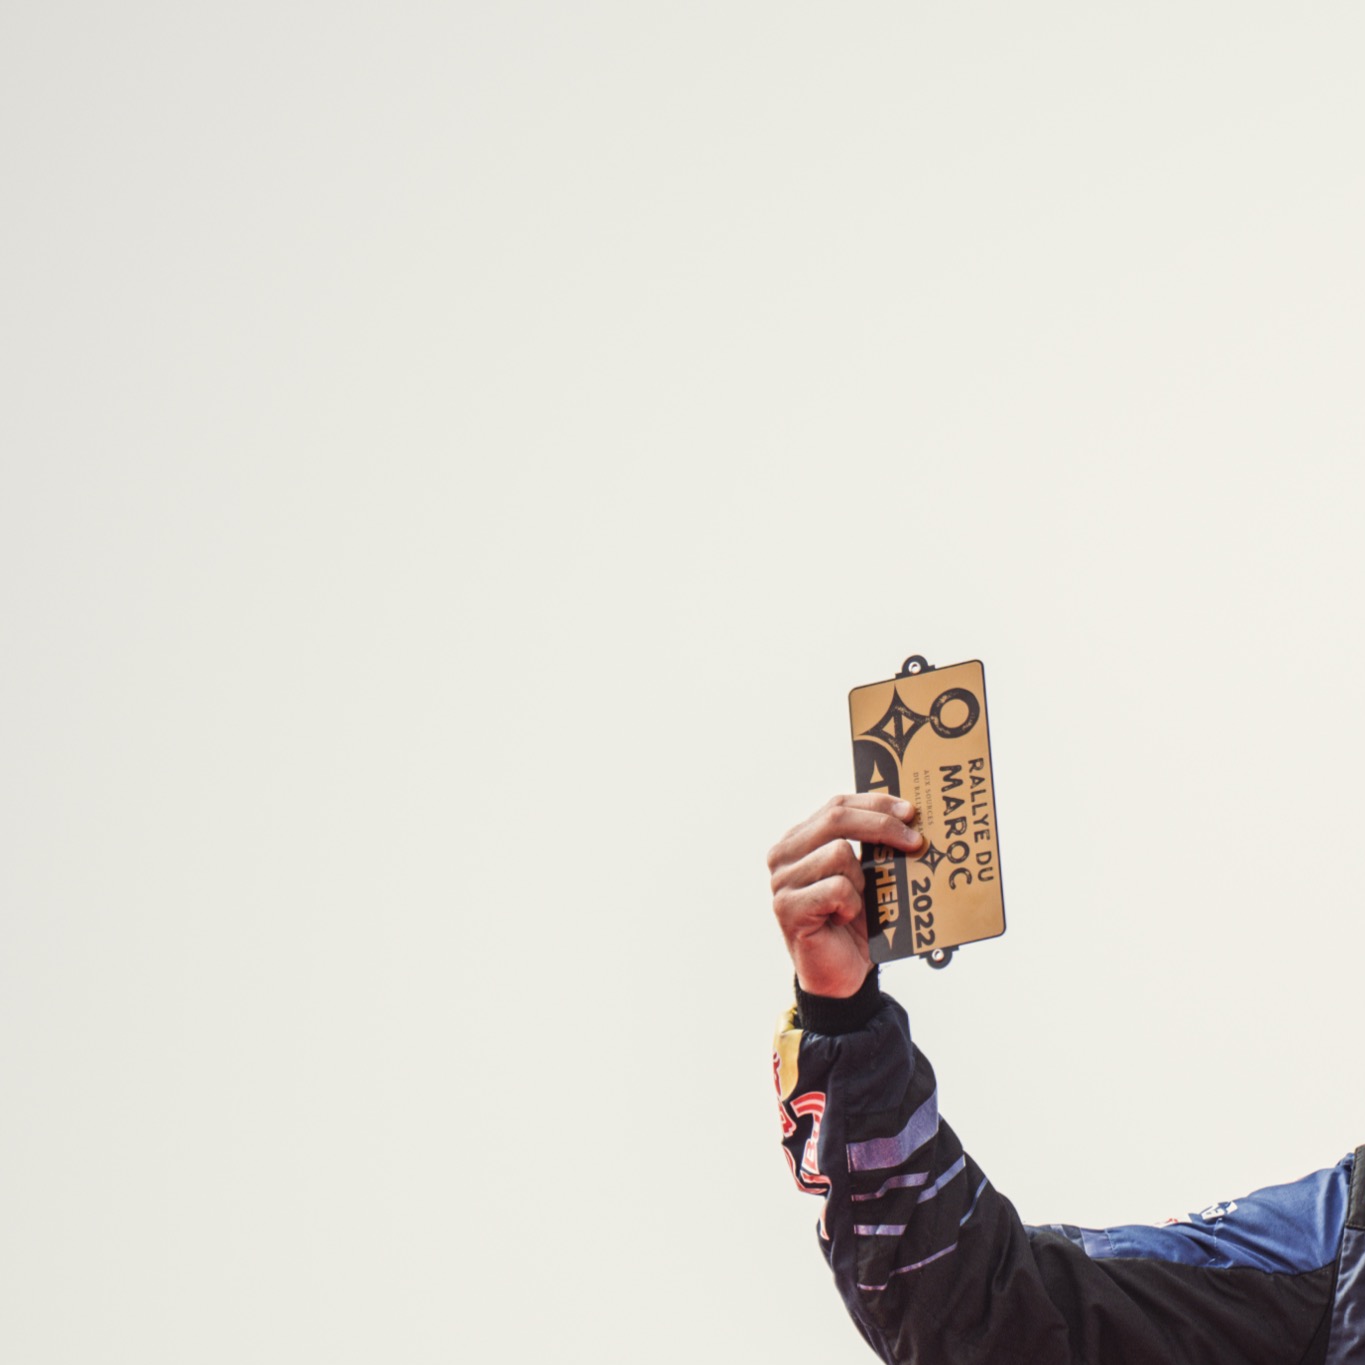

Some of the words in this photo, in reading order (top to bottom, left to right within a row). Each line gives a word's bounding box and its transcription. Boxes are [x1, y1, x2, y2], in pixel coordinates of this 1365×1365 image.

[939, 764, 973, 890] MAROC
[967, 757, 990, 843] RALLYE
[975, 851, 994, 882] DU
[911, 876, 936, 949] 2022
